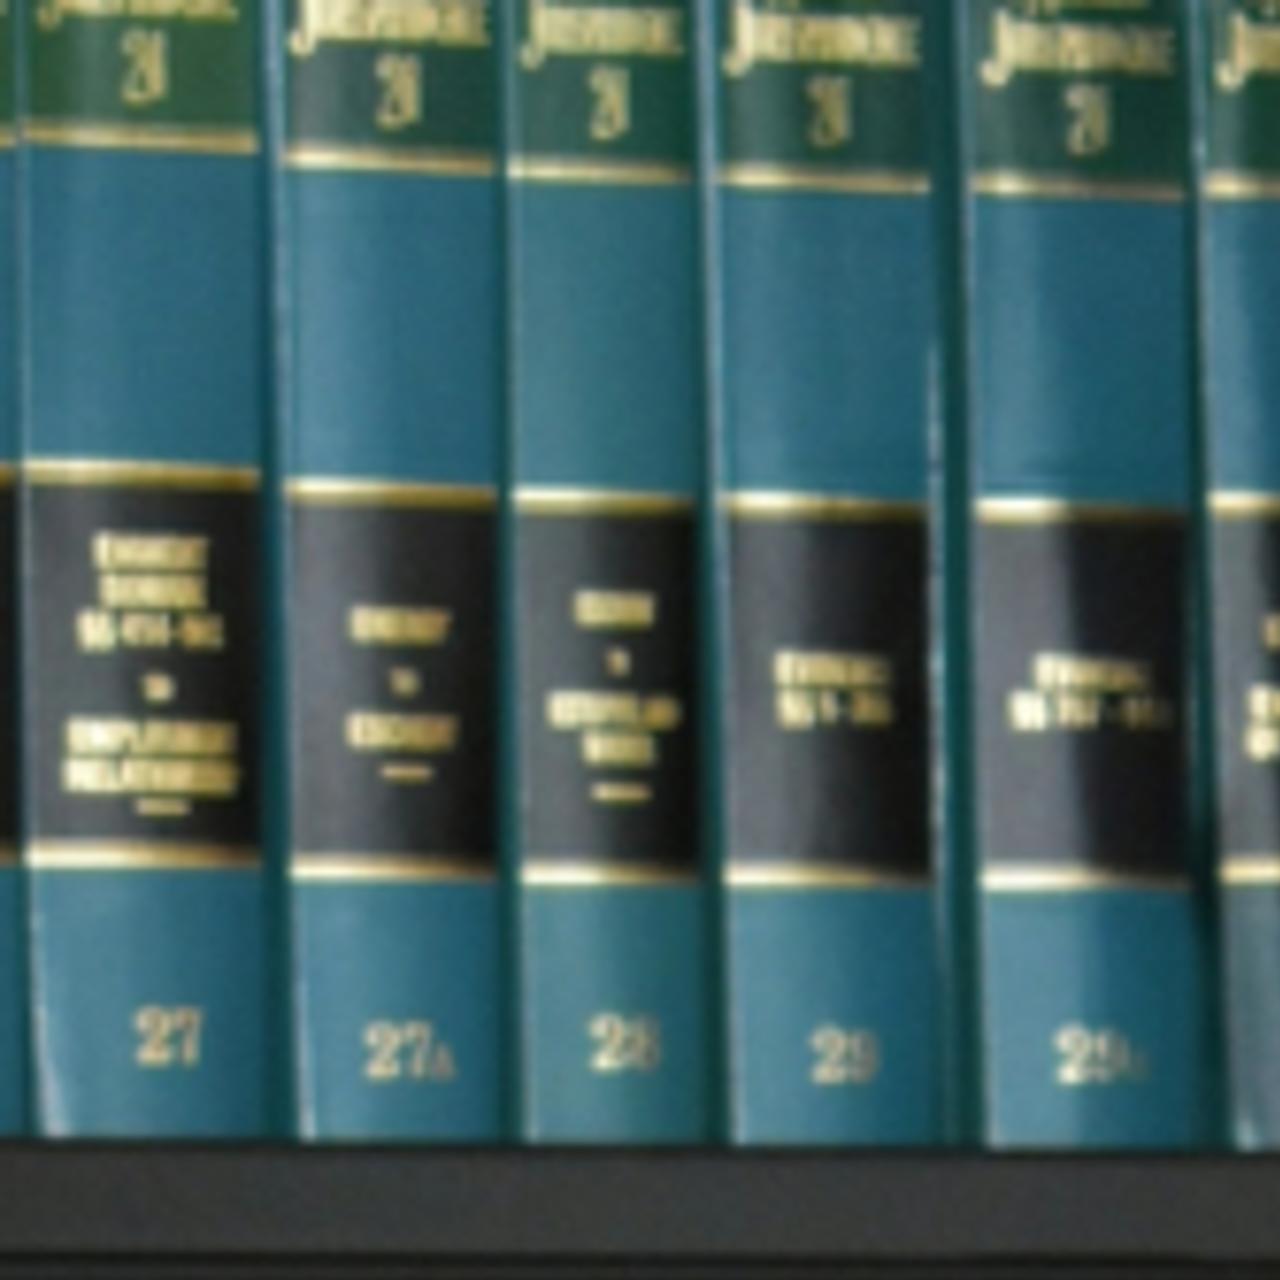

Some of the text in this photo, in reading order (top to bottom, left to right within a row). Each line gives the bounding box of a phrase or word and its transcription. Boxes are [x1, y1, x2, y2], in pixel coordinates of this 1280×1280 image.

[133, 1006, 203, 1066] 27
[587, 1013, 660, 1072] 28
[809, 1025, 878, 1084] 29
